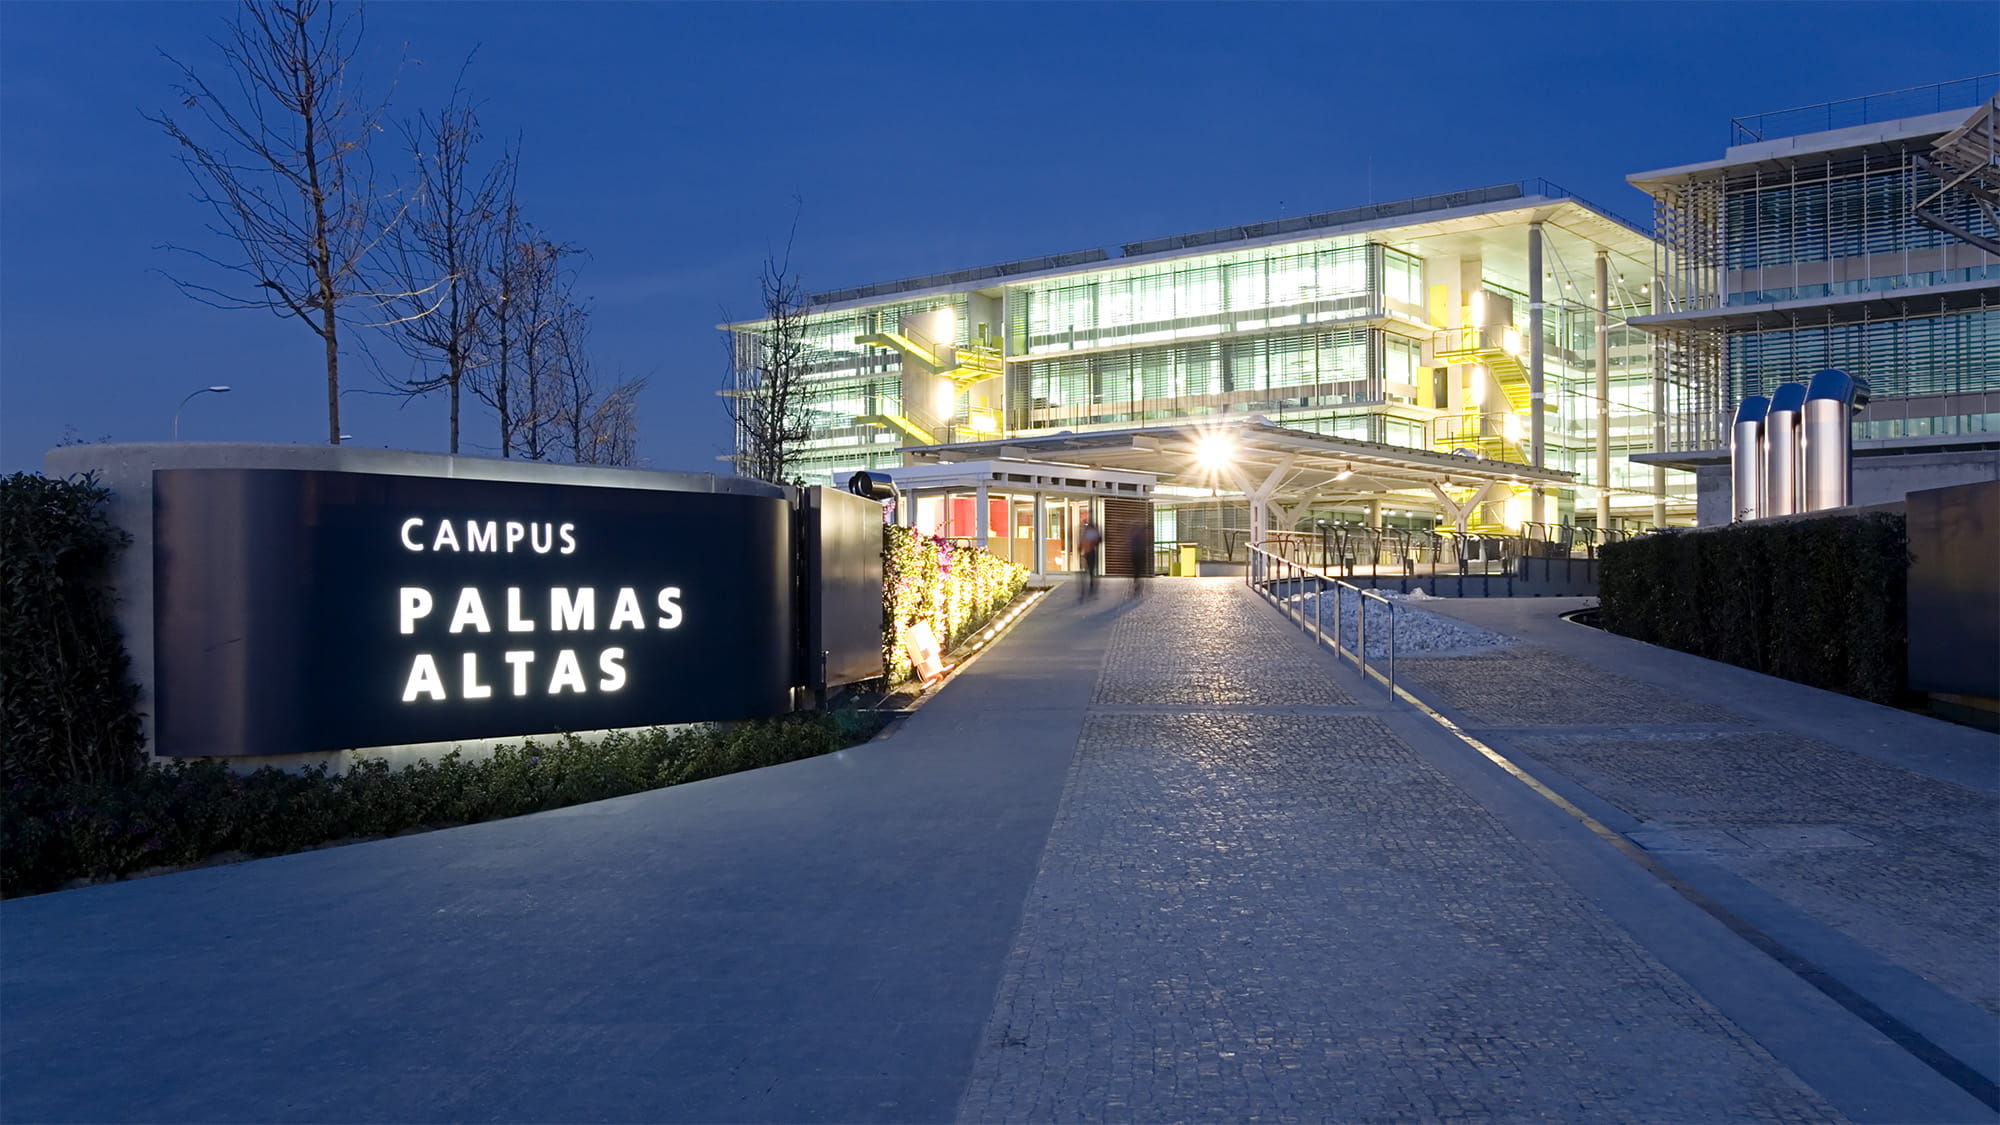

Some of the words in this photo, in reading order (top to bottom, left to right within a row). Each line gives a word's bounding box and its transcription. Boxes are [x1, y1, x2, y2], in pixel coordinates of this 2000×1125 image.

[400, 517, 576, 555] CAMPUS
[399, 586, 685, 635] PALMAS
[401, 646, 628, 703] ALTAS
